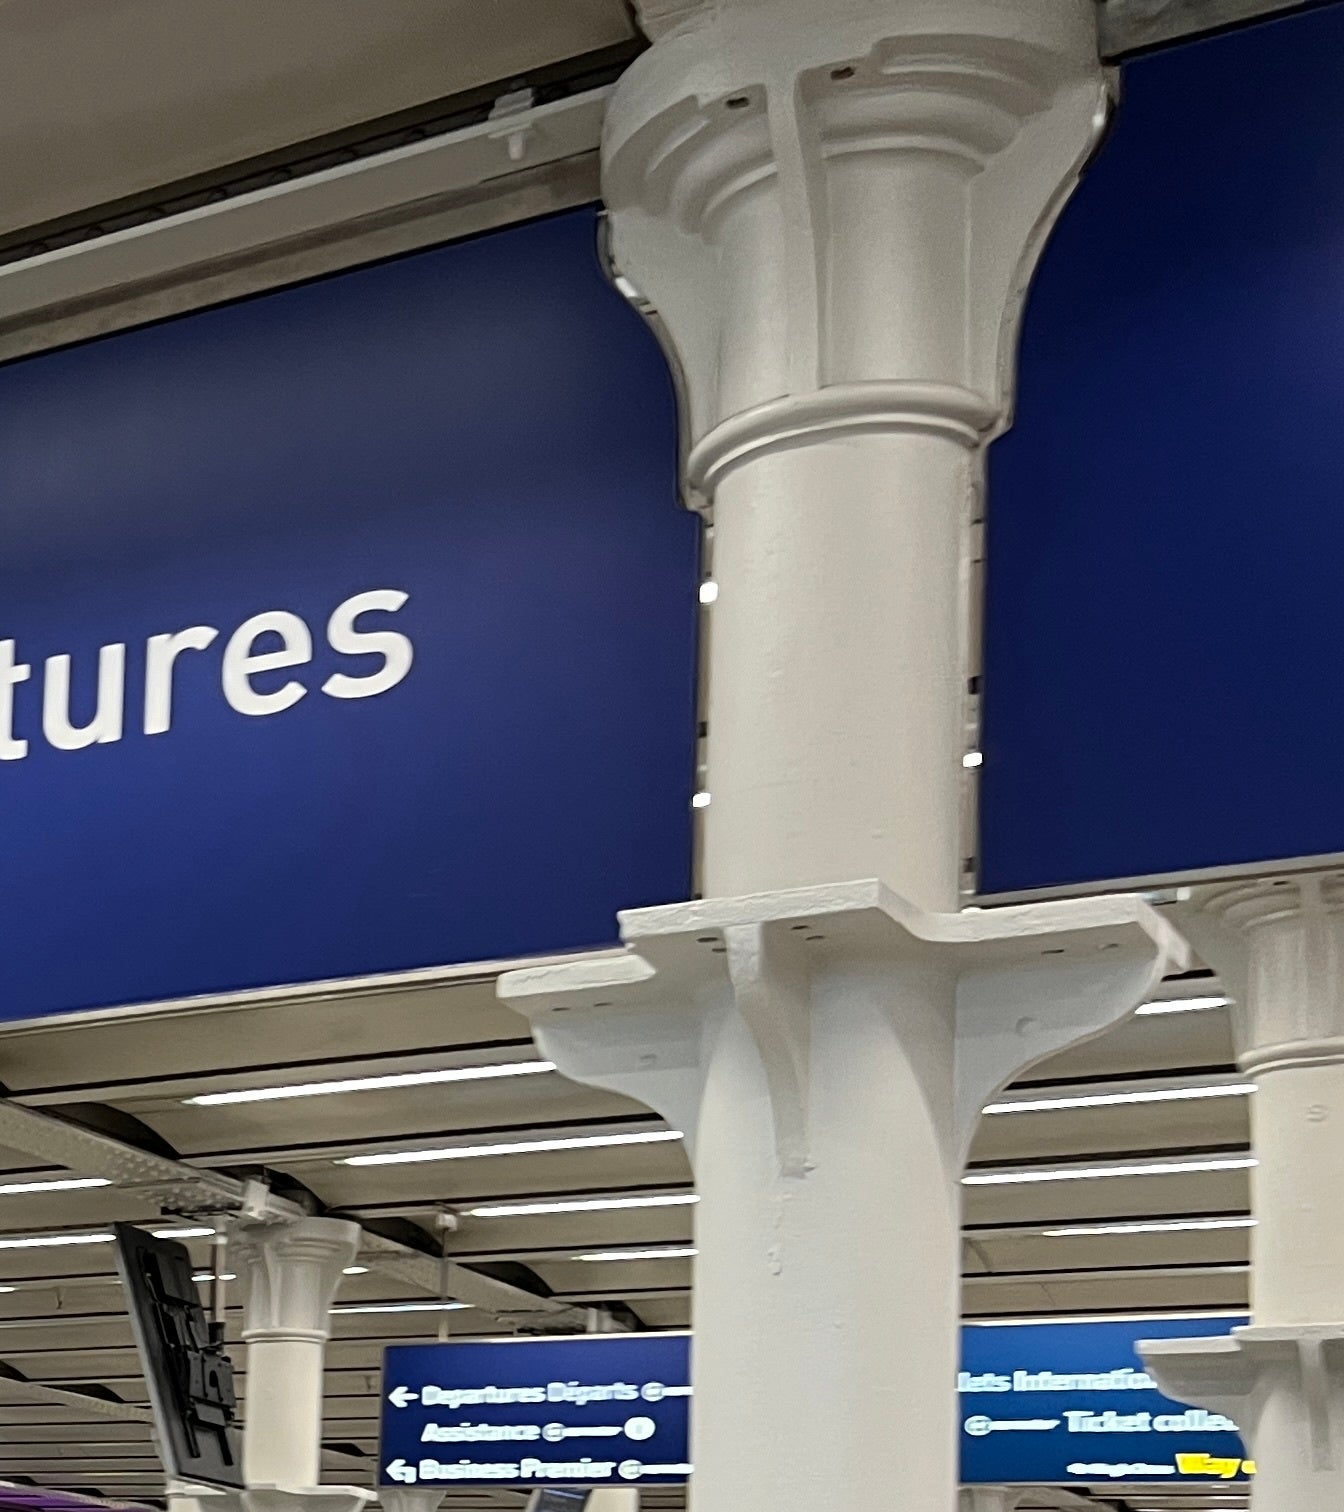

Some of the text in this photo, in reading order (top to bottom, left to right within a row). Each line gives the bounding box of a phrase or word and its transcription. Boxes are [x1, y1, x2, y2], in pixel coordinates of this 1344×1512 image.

[1013, 1367, 1158, 1391] Internatio
[421, 1385, 546, 1409] Departures
[420, 1421, 541, 1443] Assistance
[1063, 1409, 1239, 1433] Ticket colle
[418, 1456, 617, 1480] Business Premier
